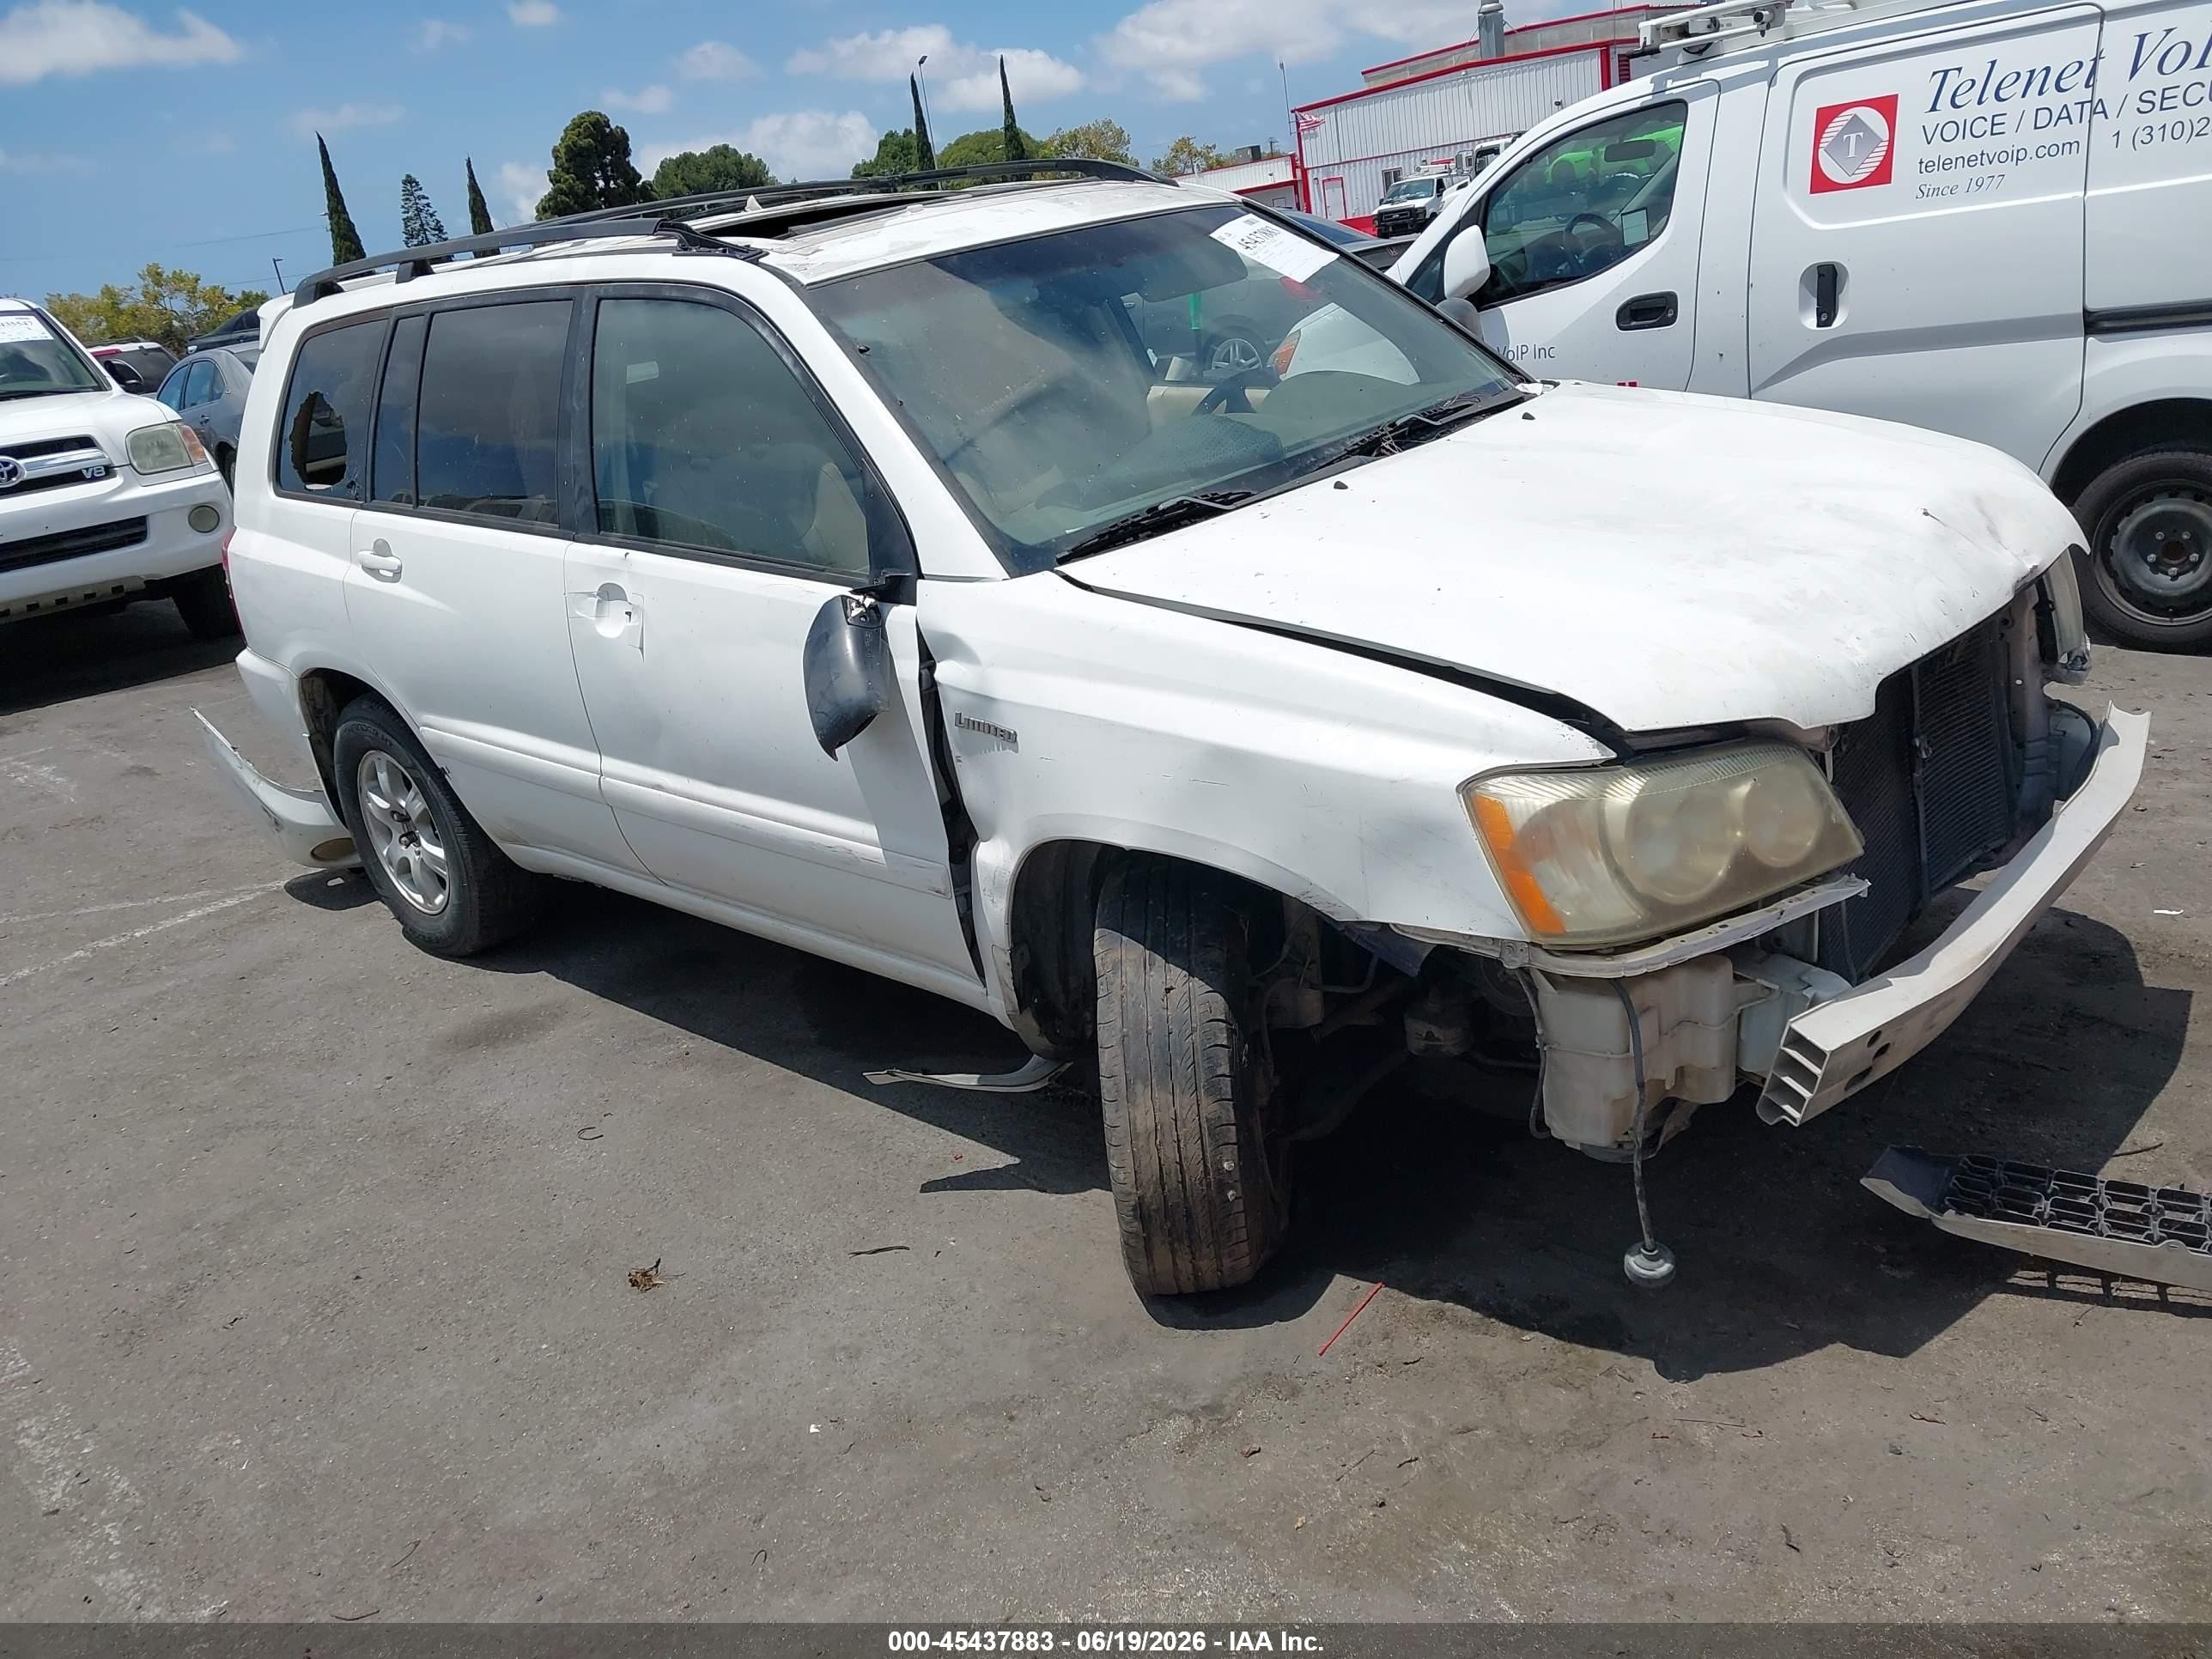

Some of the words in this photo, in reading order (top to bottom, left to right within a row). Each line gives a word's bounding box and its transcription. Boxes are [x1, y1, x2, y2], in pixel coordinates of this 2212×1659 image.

[1923, 48, 2106, 113] Telenet
[1922, 112, 2008, 145] VOICE
[2014, 109, 2026, 133] /
[2033, 98, 2109, 131] DATA
[2116, 93, 2129, 118] /
[2136, 79, 2212, 114] SEC
[1843, 131, 1864, 158] T
[1917, 140, 2081, 174] telenetvoip.com
[2111, 130, 2121, 149] 1
[1916, 183, 1959, 199] Since
[1966, 173, 2006, 193] 1977
[1497, 343, 1528, 362] VoIP
[1534, 343, 1556, 360] Inc
[82, 465, 106, 479] V8
